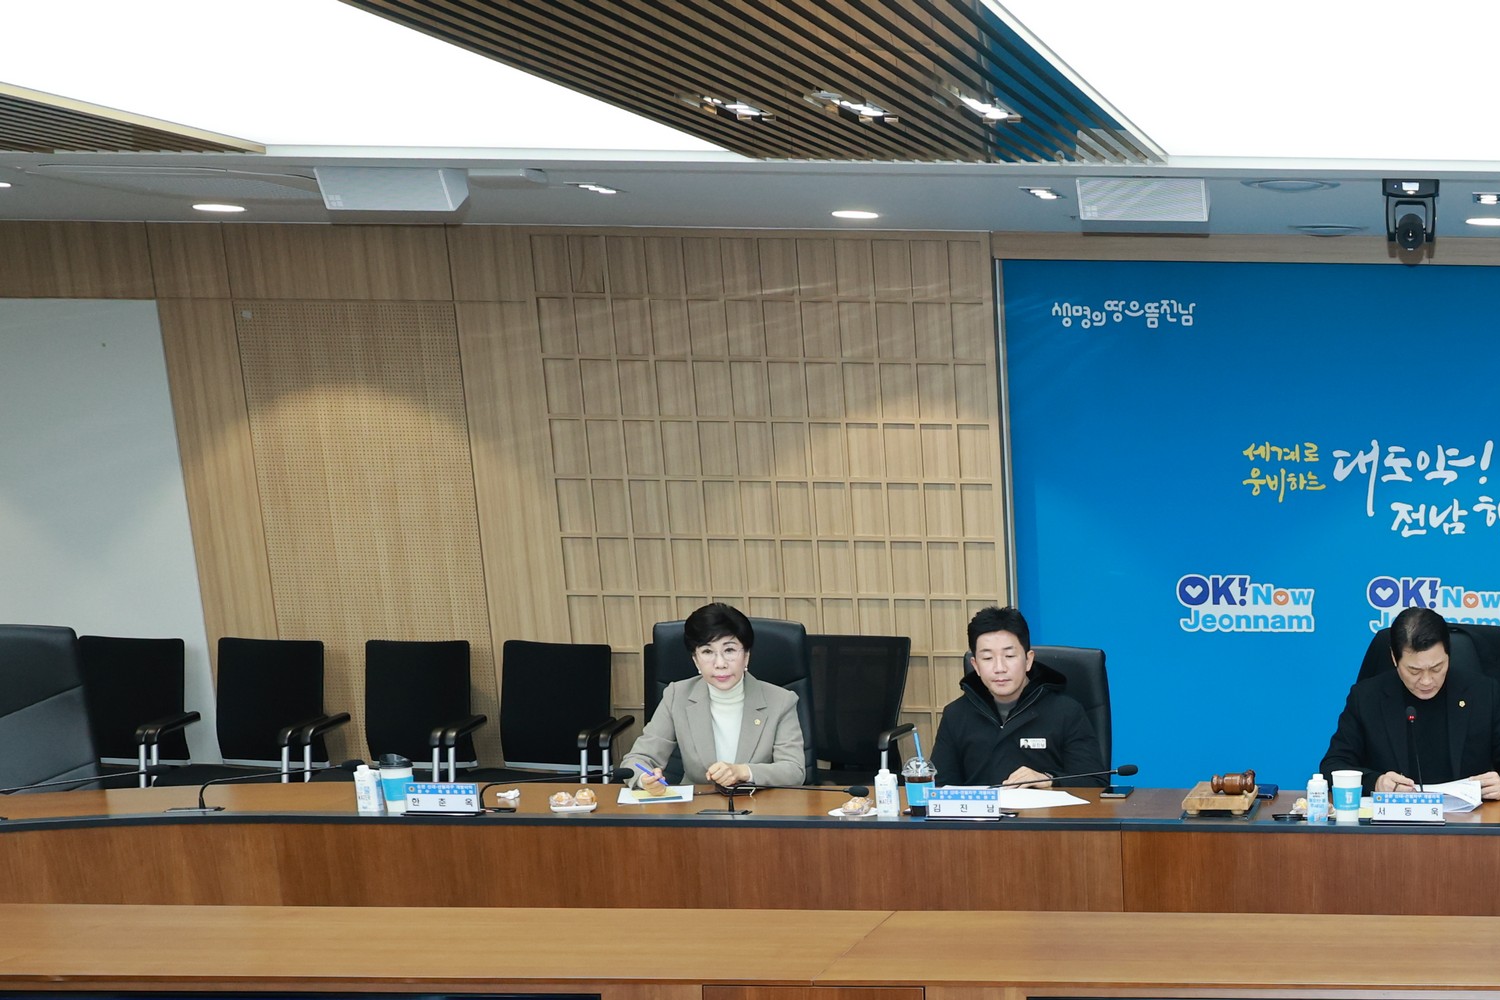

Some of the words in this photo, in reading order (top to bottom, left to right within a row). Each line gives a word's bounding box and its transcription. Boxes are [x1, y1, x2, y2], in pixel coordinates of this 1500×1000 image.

[1242, 442, 1319, 463] 세계로
[1390, 499, 1468, 537] 전남
[1178, 576, 1248, 606] OK!
[1253, 584, 1312, 606] Now
[1443, 588, 1500, 608] Now
[1181, 610, 1312, 630] Jeonnam
[933, 804, 941, 812] 김
[987, 805, 994, 813] 남
[1404, 808, 1412, 816] 동
